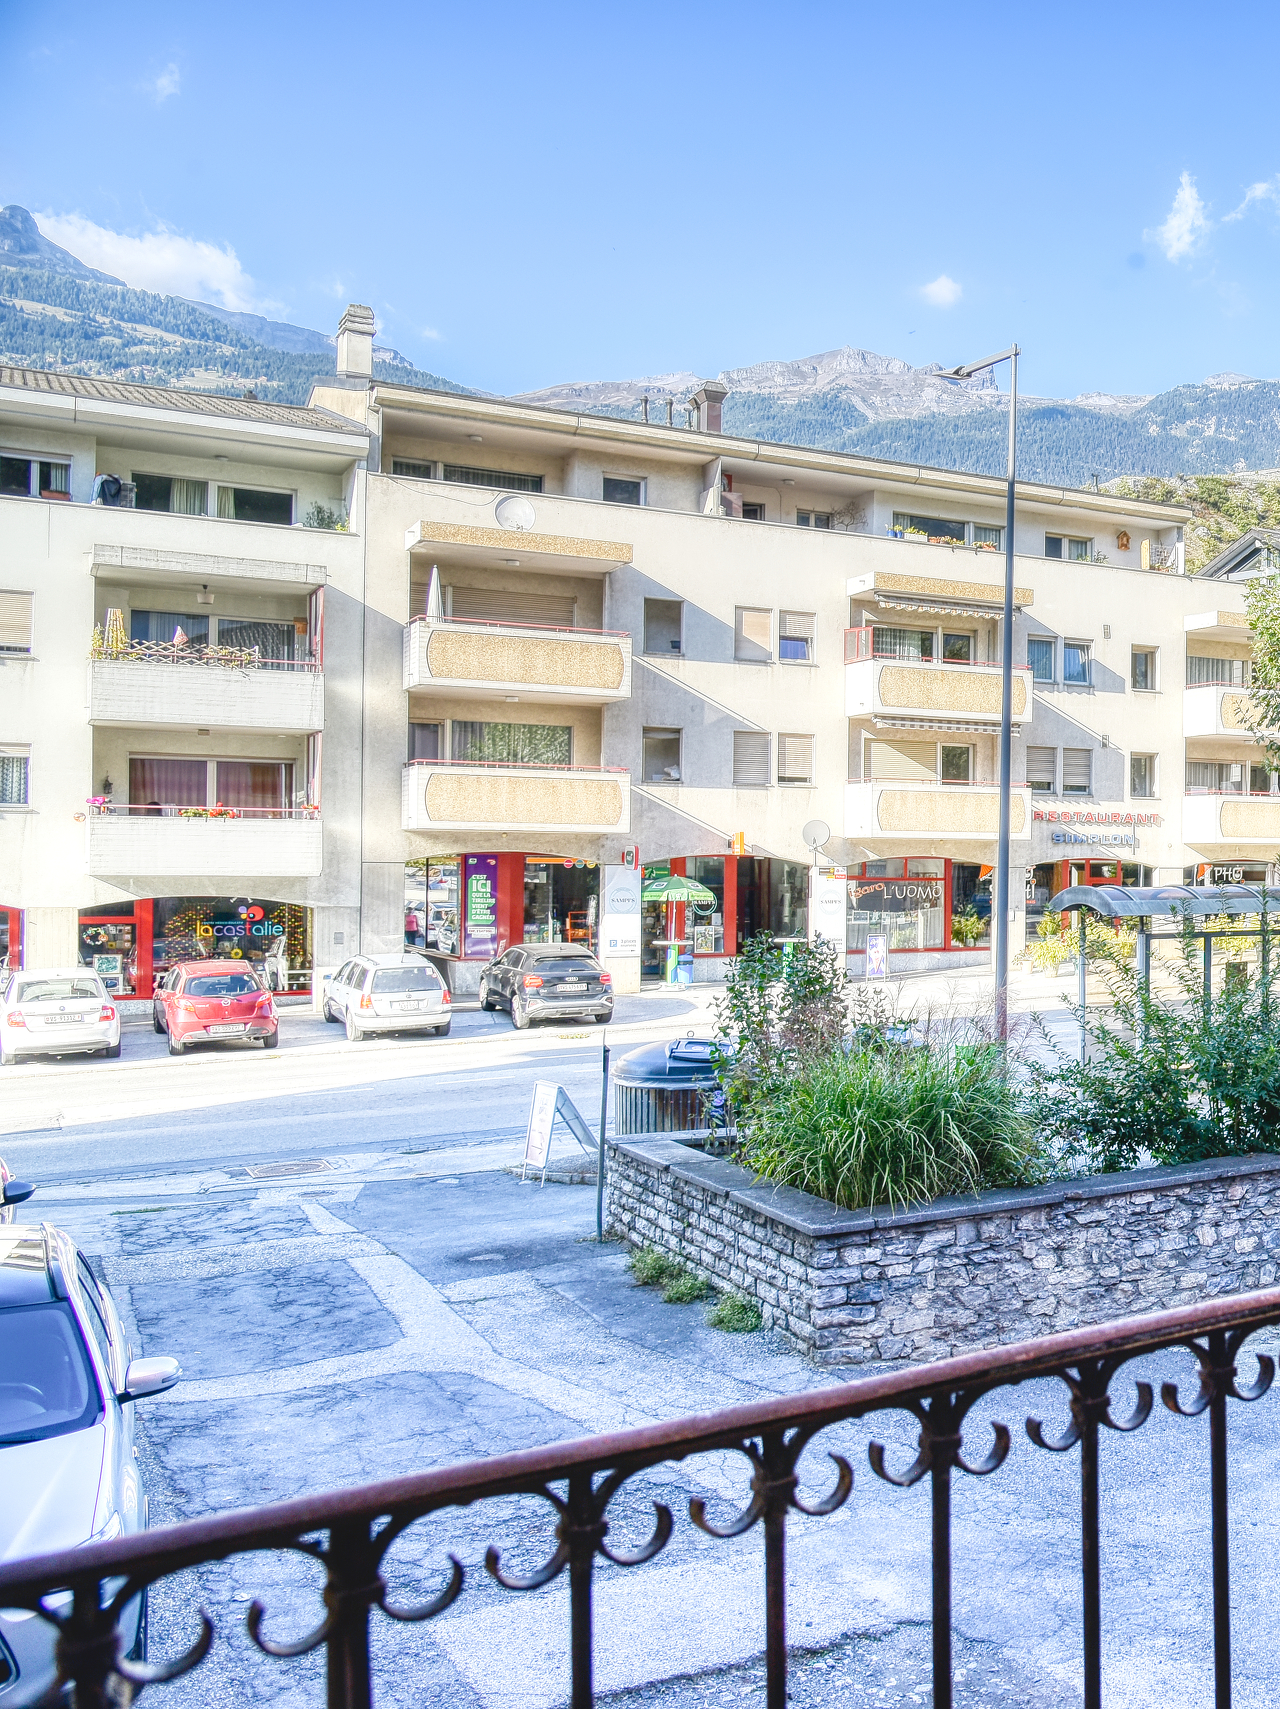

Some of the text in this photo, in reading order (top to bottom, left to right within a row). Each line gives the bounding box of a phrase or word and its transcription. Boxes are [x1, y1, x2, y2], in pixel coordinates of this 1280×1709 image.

[1033, 811, 1159, 823] RESTAURANT
[1052, 833, 1135, 845] SIMPLON
[472, 880, 492, 892] ICI
[884, 885, 943, 899] L'UOMO
